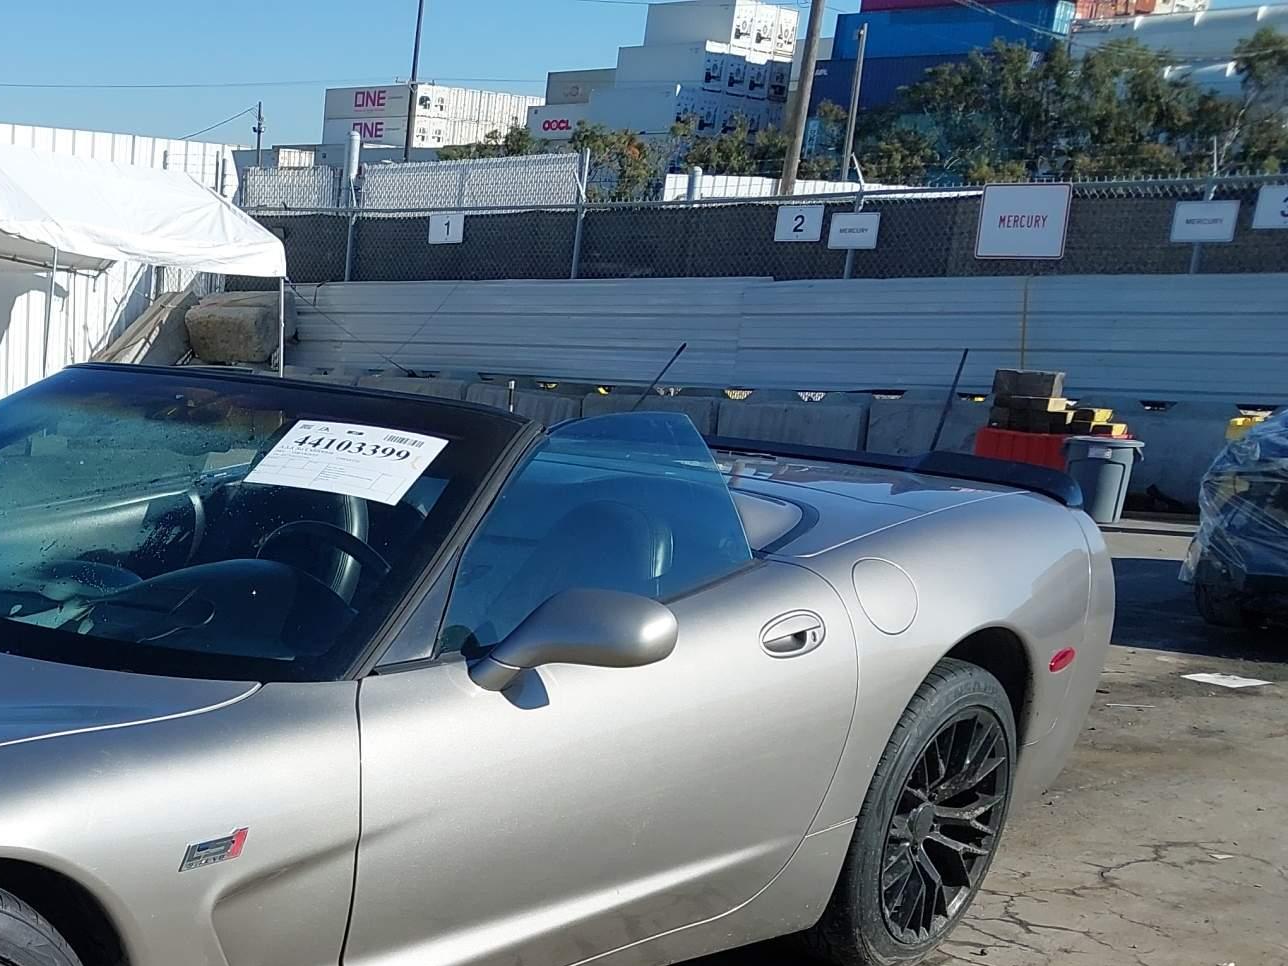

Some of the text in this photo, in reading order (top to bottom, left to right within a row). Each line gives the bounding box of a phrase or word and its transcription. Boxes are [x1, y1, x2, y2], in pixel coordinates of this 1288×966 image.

[354, 90, 387, 107] ONE
[543, 119, 572, 131] OOCL
[444, 220, 450, 236] 1
[793, 214, 806, 233] 2
[998, 214, 1048, 229] MERCURY
[294, 435, 411, 461] 44103399
